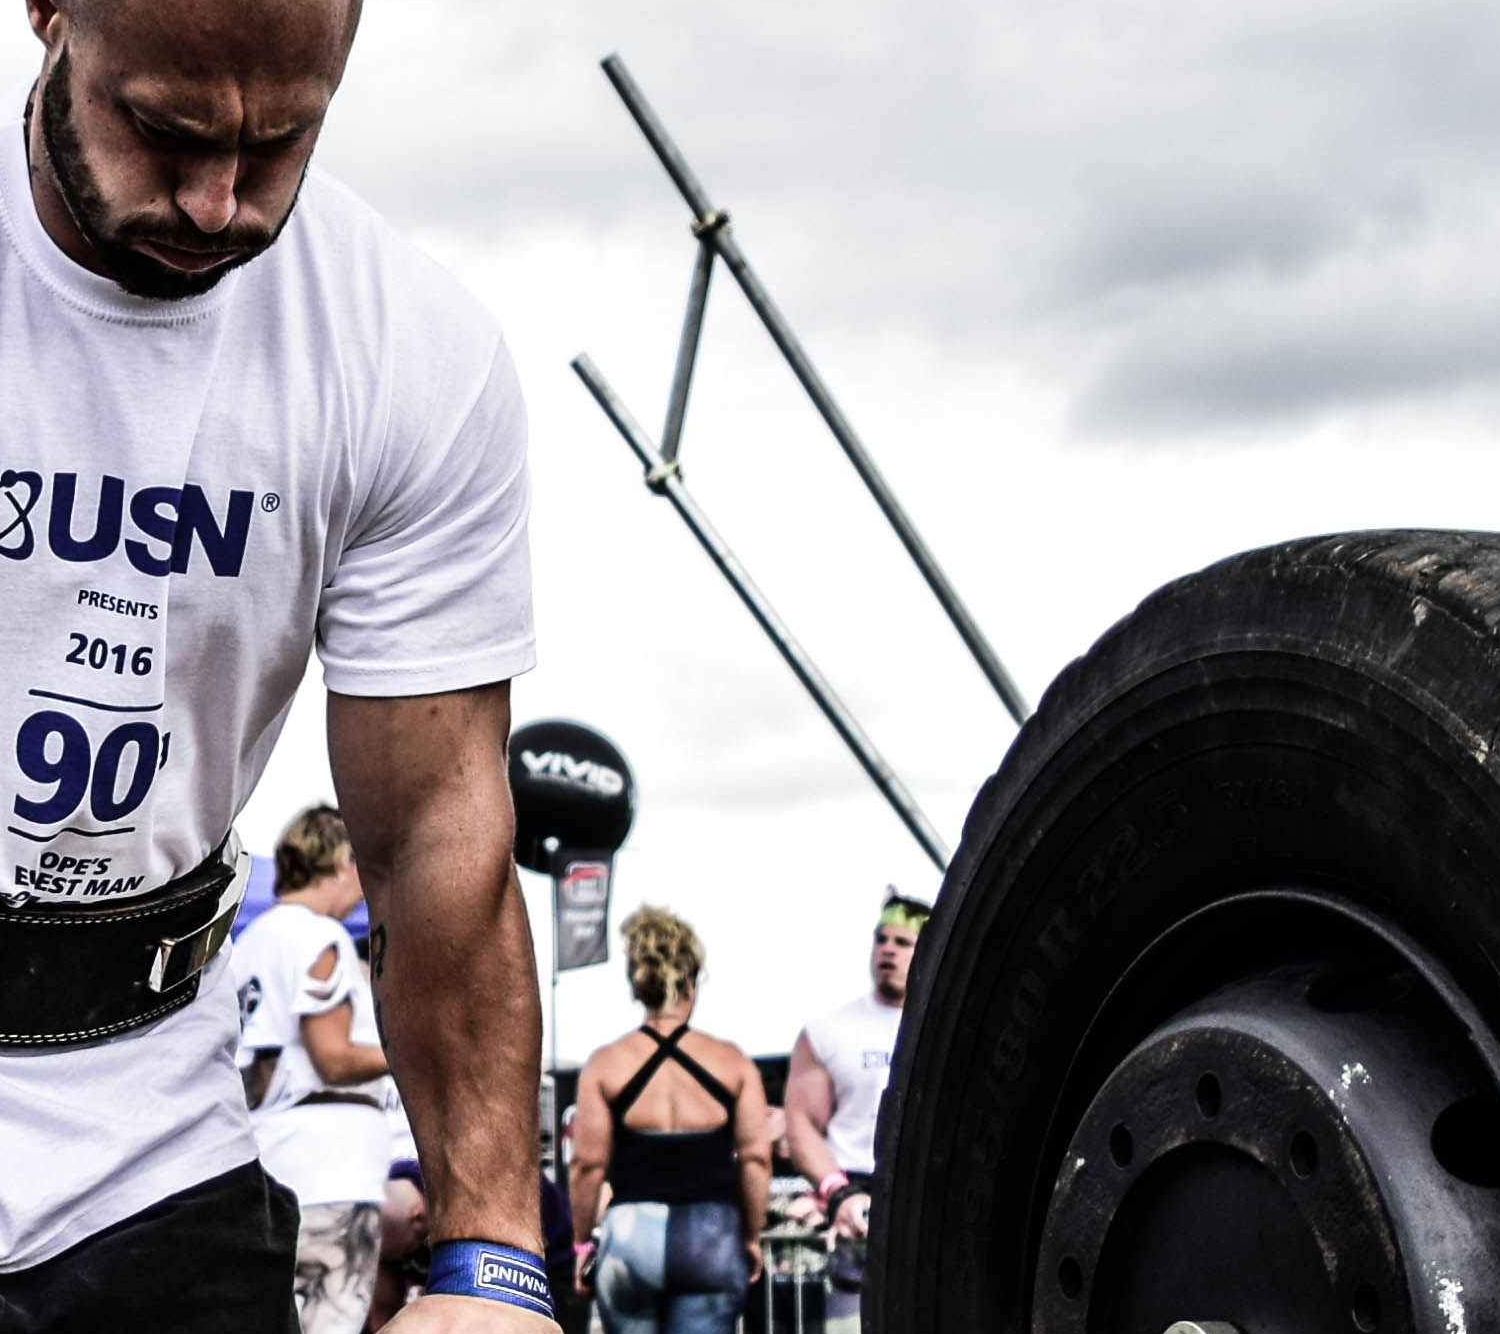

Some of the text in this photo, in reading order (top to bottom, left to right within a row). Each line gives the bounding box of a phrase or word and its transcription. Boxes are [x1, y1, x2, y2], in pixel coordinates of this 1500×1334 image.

[77, 589, 159, 620] PRESENTS
[65, 632, 154, 677] 2016
[13, 710, 160, 825] 90
[520, 750, 624, 796] VIVID
[83, 875, 145, 897] MAN
[484, 1263, 548, 1295] NMIND
